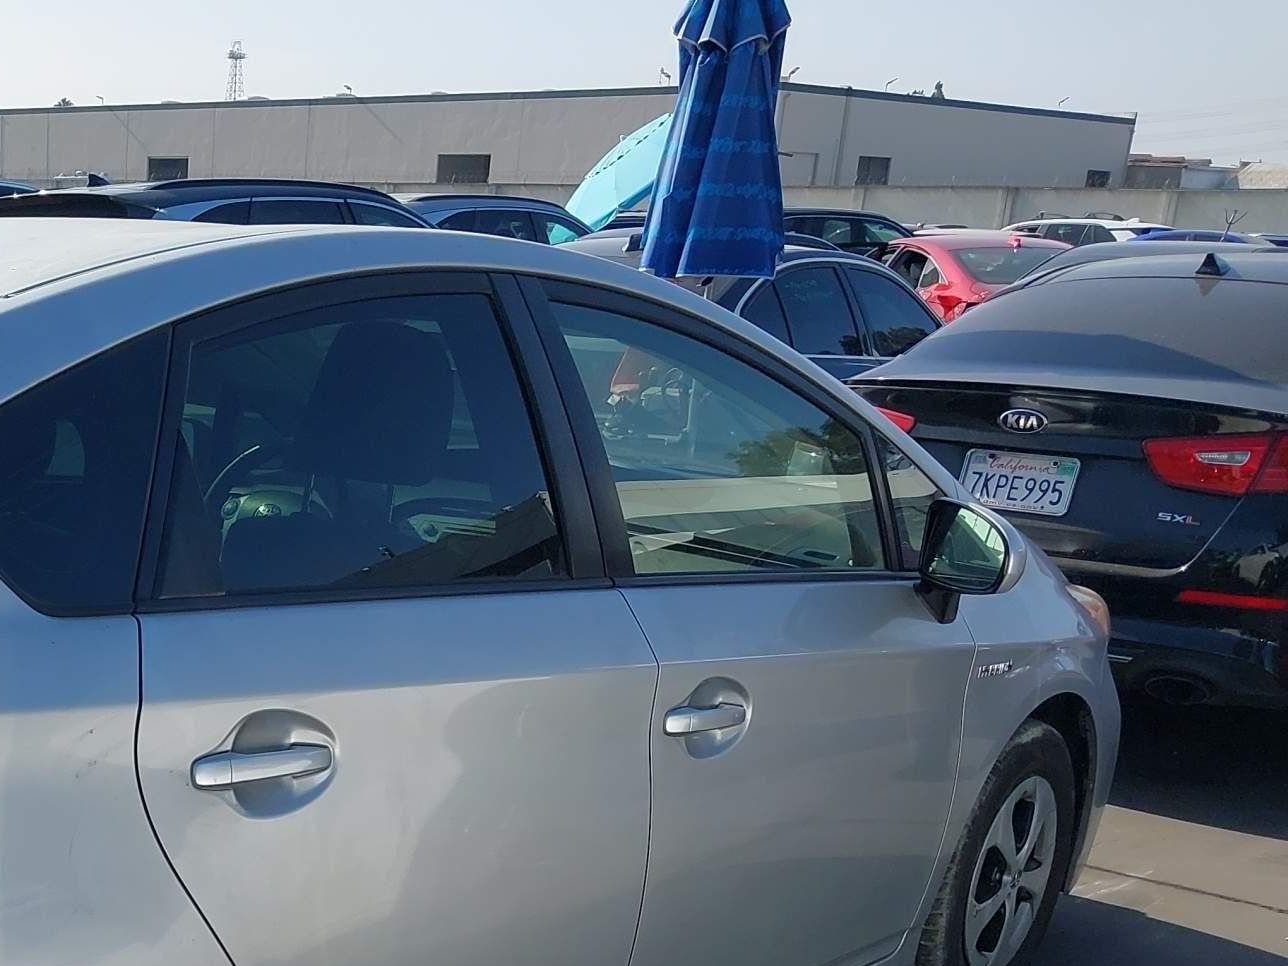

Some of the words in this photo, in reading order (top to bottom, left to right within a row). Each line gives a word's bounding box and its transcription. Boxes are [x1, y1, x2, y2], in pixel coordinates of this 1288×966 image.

[1007, 414, 1039, 429] KIA
[989, 456, 1056, 475] California
[970, 471, 1065, 506] 7KPE995
